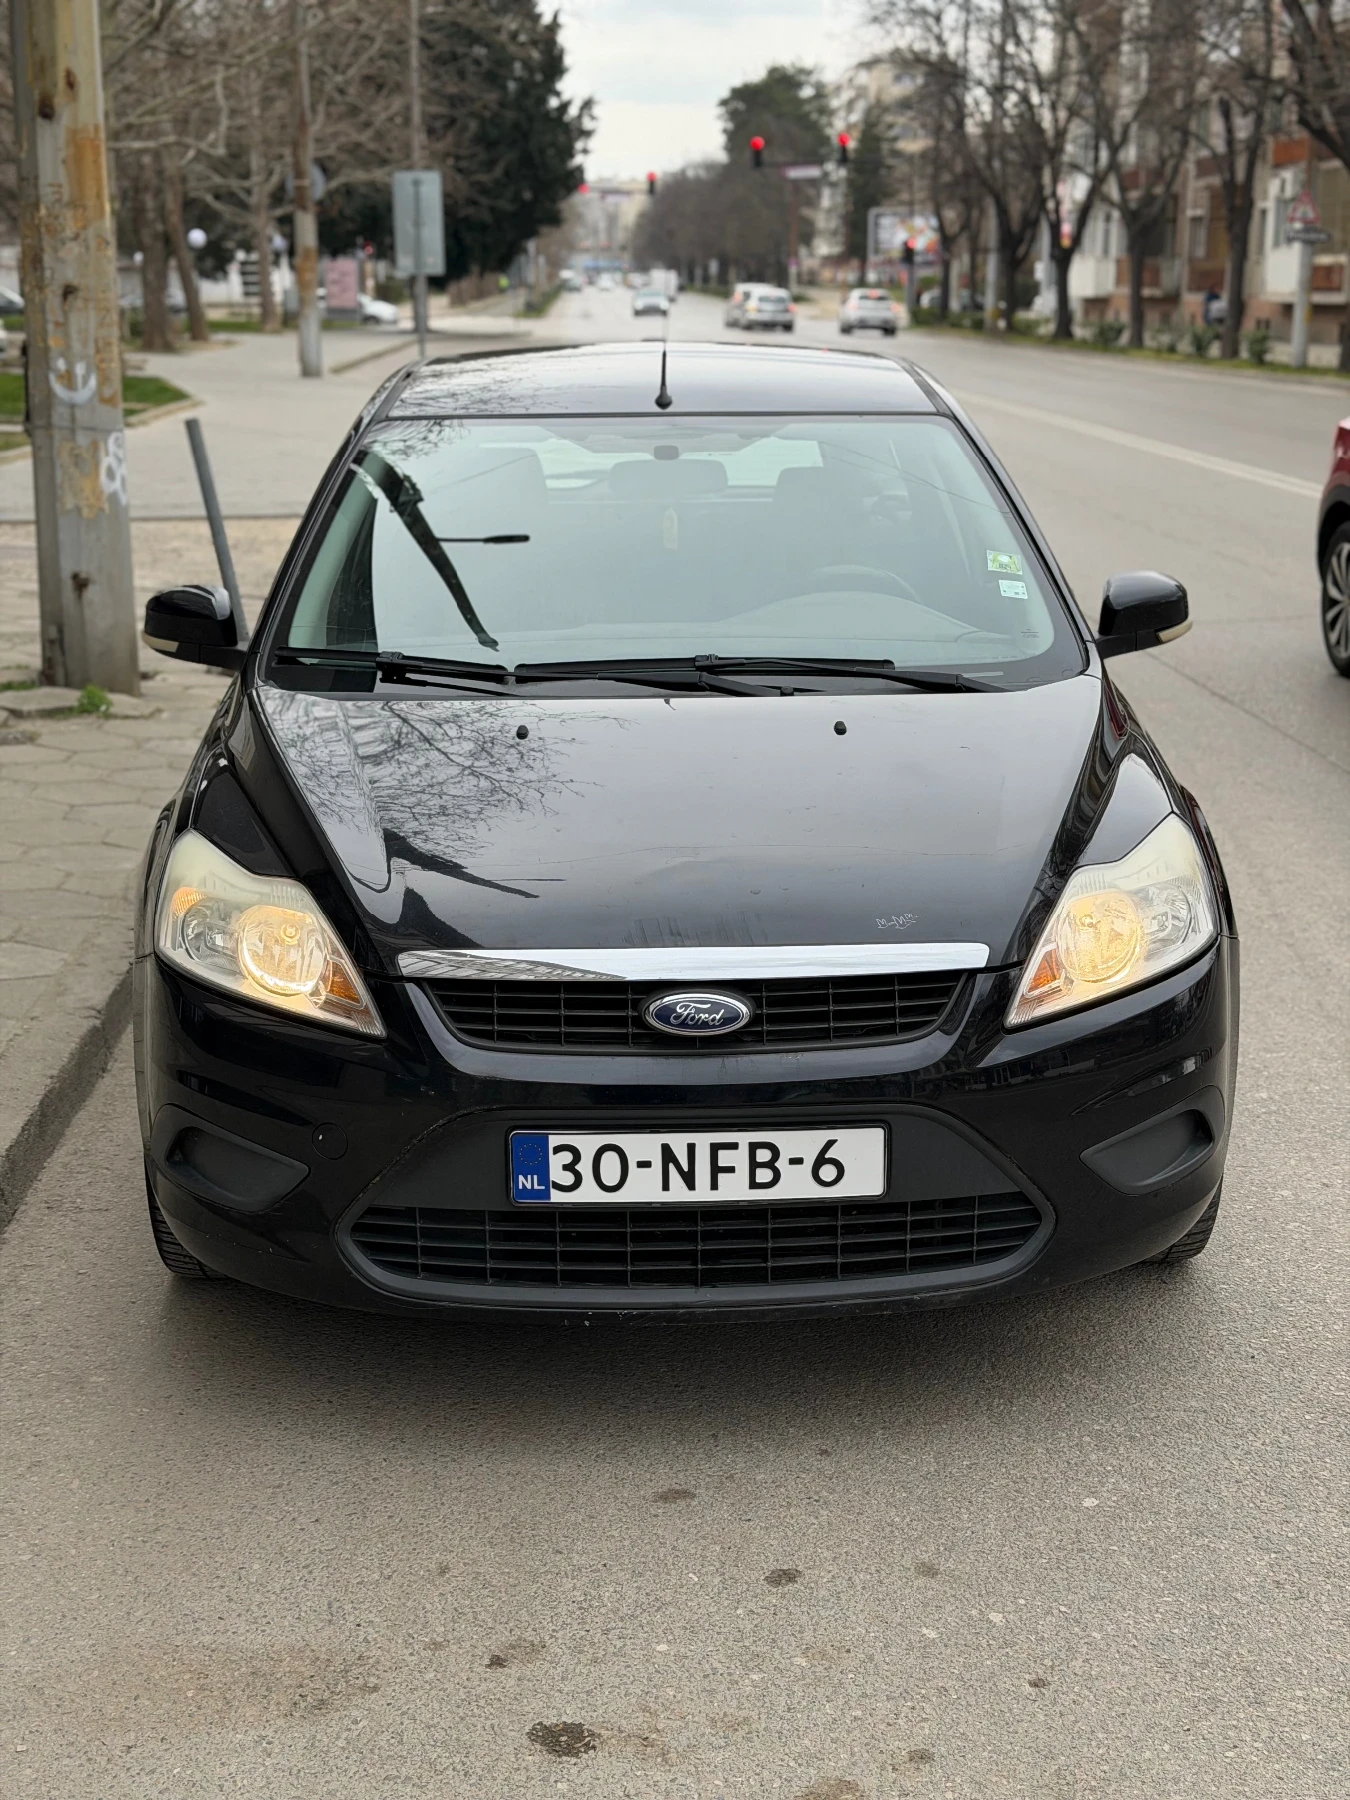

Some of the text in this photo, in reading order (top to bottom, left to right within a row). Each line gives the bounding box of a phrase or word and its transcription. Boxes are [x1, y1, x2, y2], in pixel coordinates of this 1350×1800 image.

[670, 1002, 724, 1025] Ford
[551, 1139, 846, 1193] 30-NFB-6
[518, 1174, 545, 1190] NL
